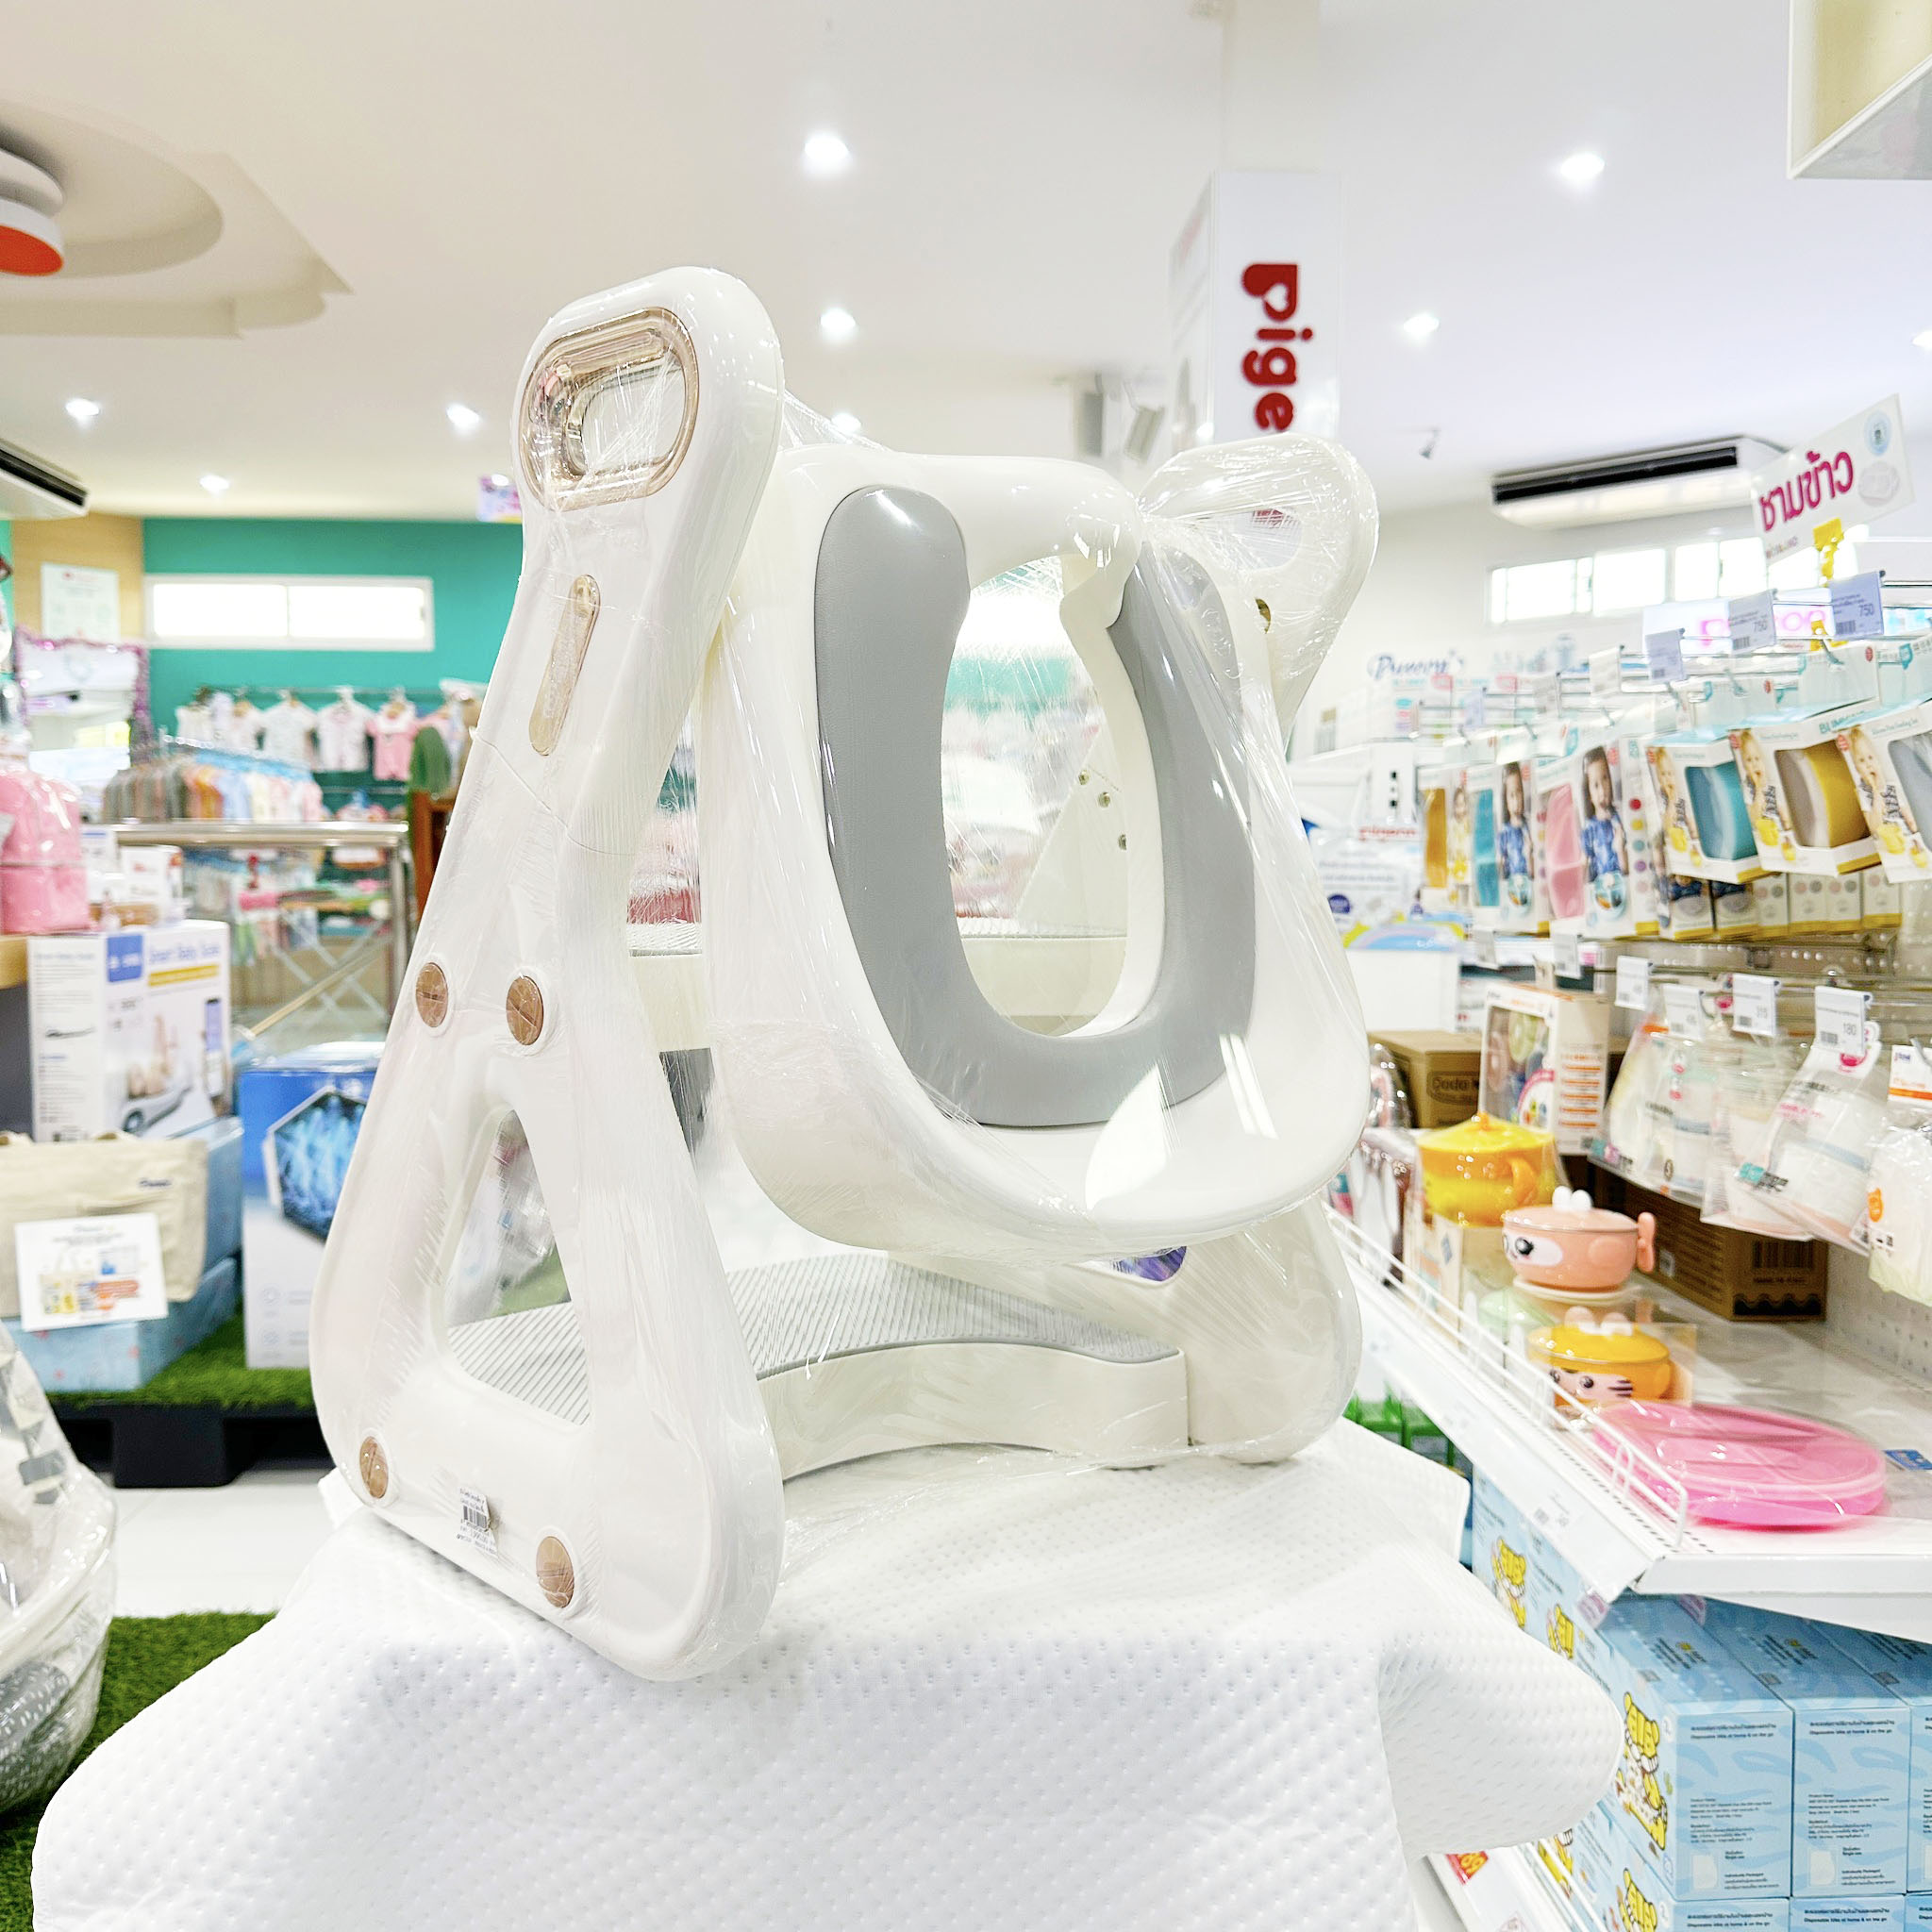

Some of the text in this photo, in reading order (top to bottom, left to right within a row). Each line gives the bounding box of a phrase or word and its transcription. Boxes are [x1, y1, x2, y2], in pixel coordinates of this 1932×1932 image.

[1759, 450, 1854, 532] ชามข้าว
[1858, 604, 1874, 617] 750
[1753, 620, 1767, 632] 750
[1843, 1022, 1857, 1036] 180
